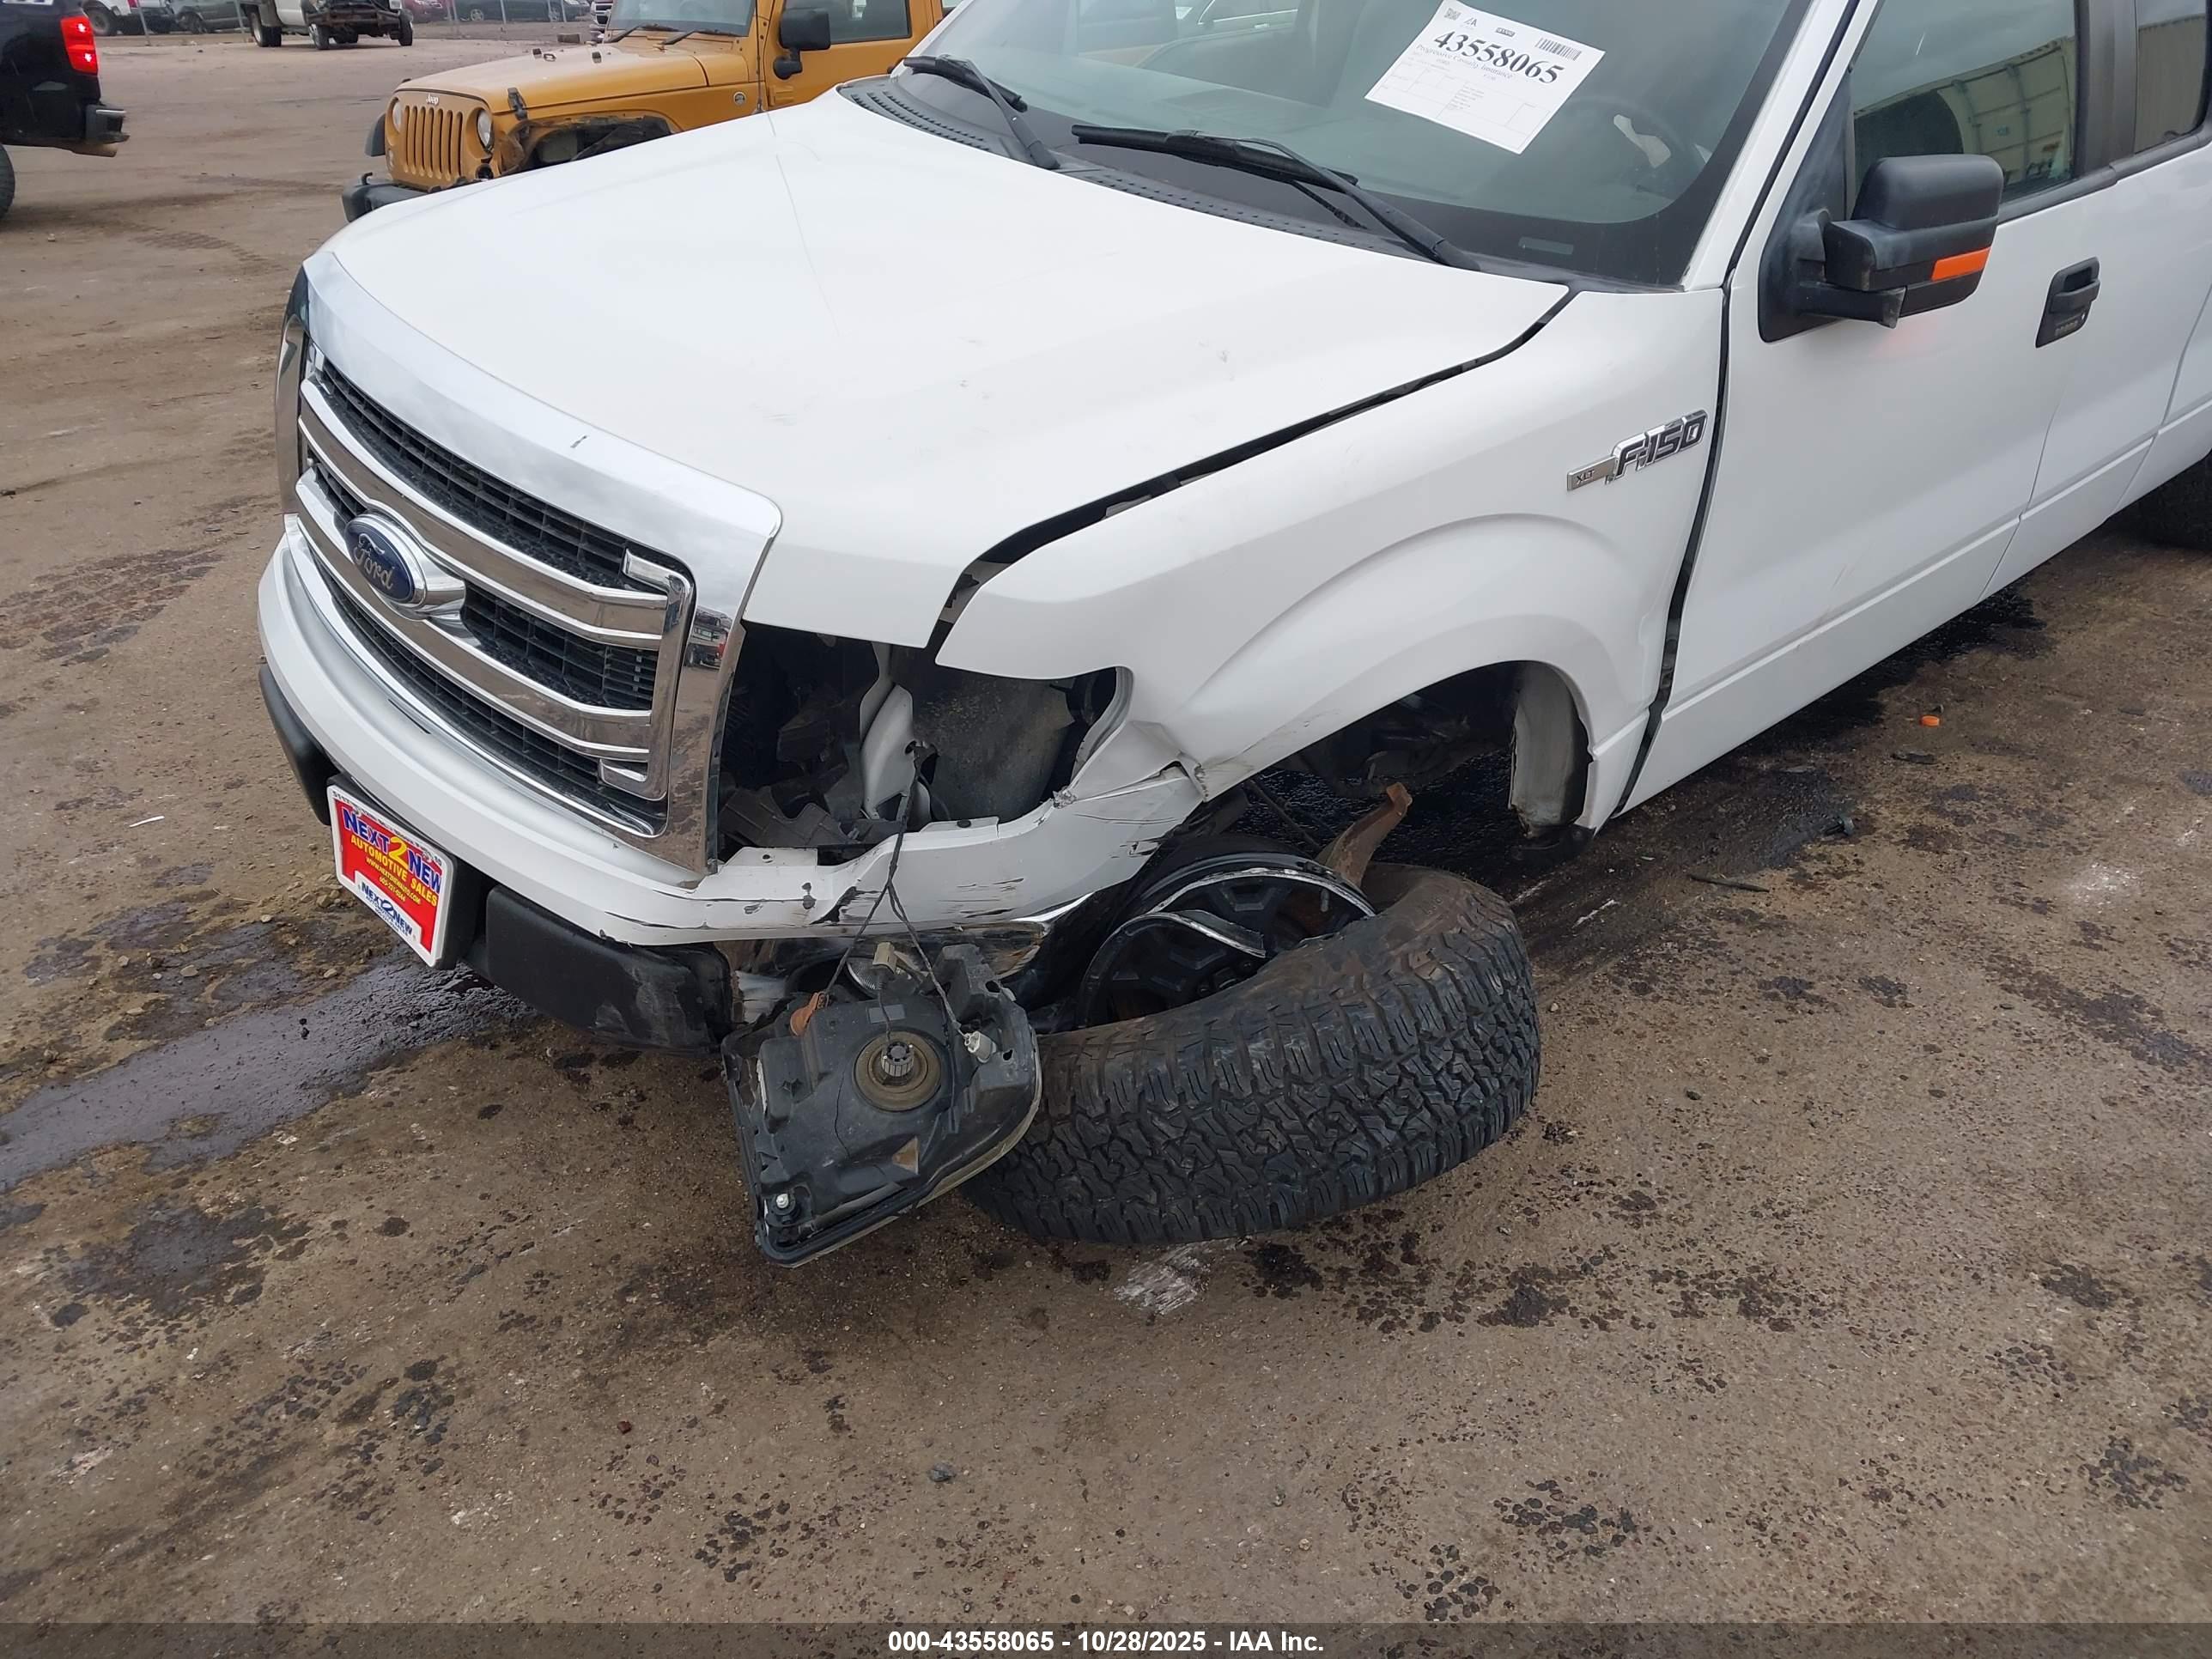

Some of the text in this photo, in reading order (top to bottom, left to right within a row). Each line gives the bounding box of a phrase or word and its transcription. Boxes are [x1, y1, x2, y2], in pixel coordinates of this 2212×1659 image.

[1433, 31, 1565, 84] 43558065
[1576, 469, 1595, 483] XLT
[353, 532, 396, 590] Ford
[350, 834, 439, 908] AUTOMOTIVE SALES
